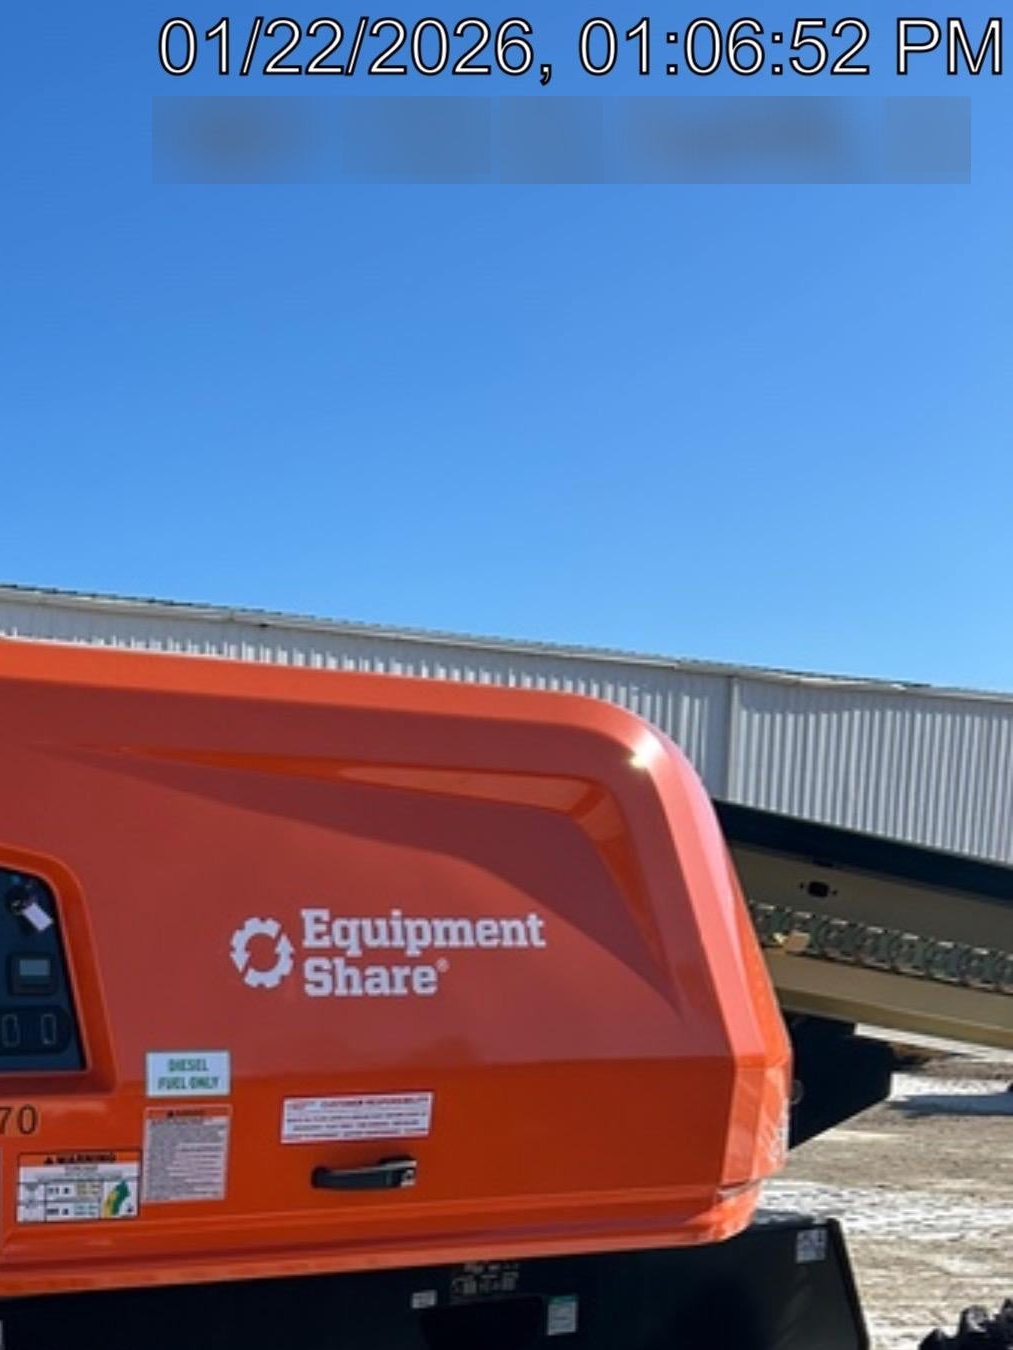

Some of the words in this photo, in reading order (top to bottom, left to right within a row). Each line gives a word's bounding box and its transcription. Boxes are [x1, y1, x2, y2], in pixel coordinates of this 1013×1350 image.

[301, 908, 546, 957] Equipment
[169, 1058, 209, 1073] DIESEL
[156, 1076, 188, 1090] FUEL
[189, 1076, 219, 1090] ONLY
